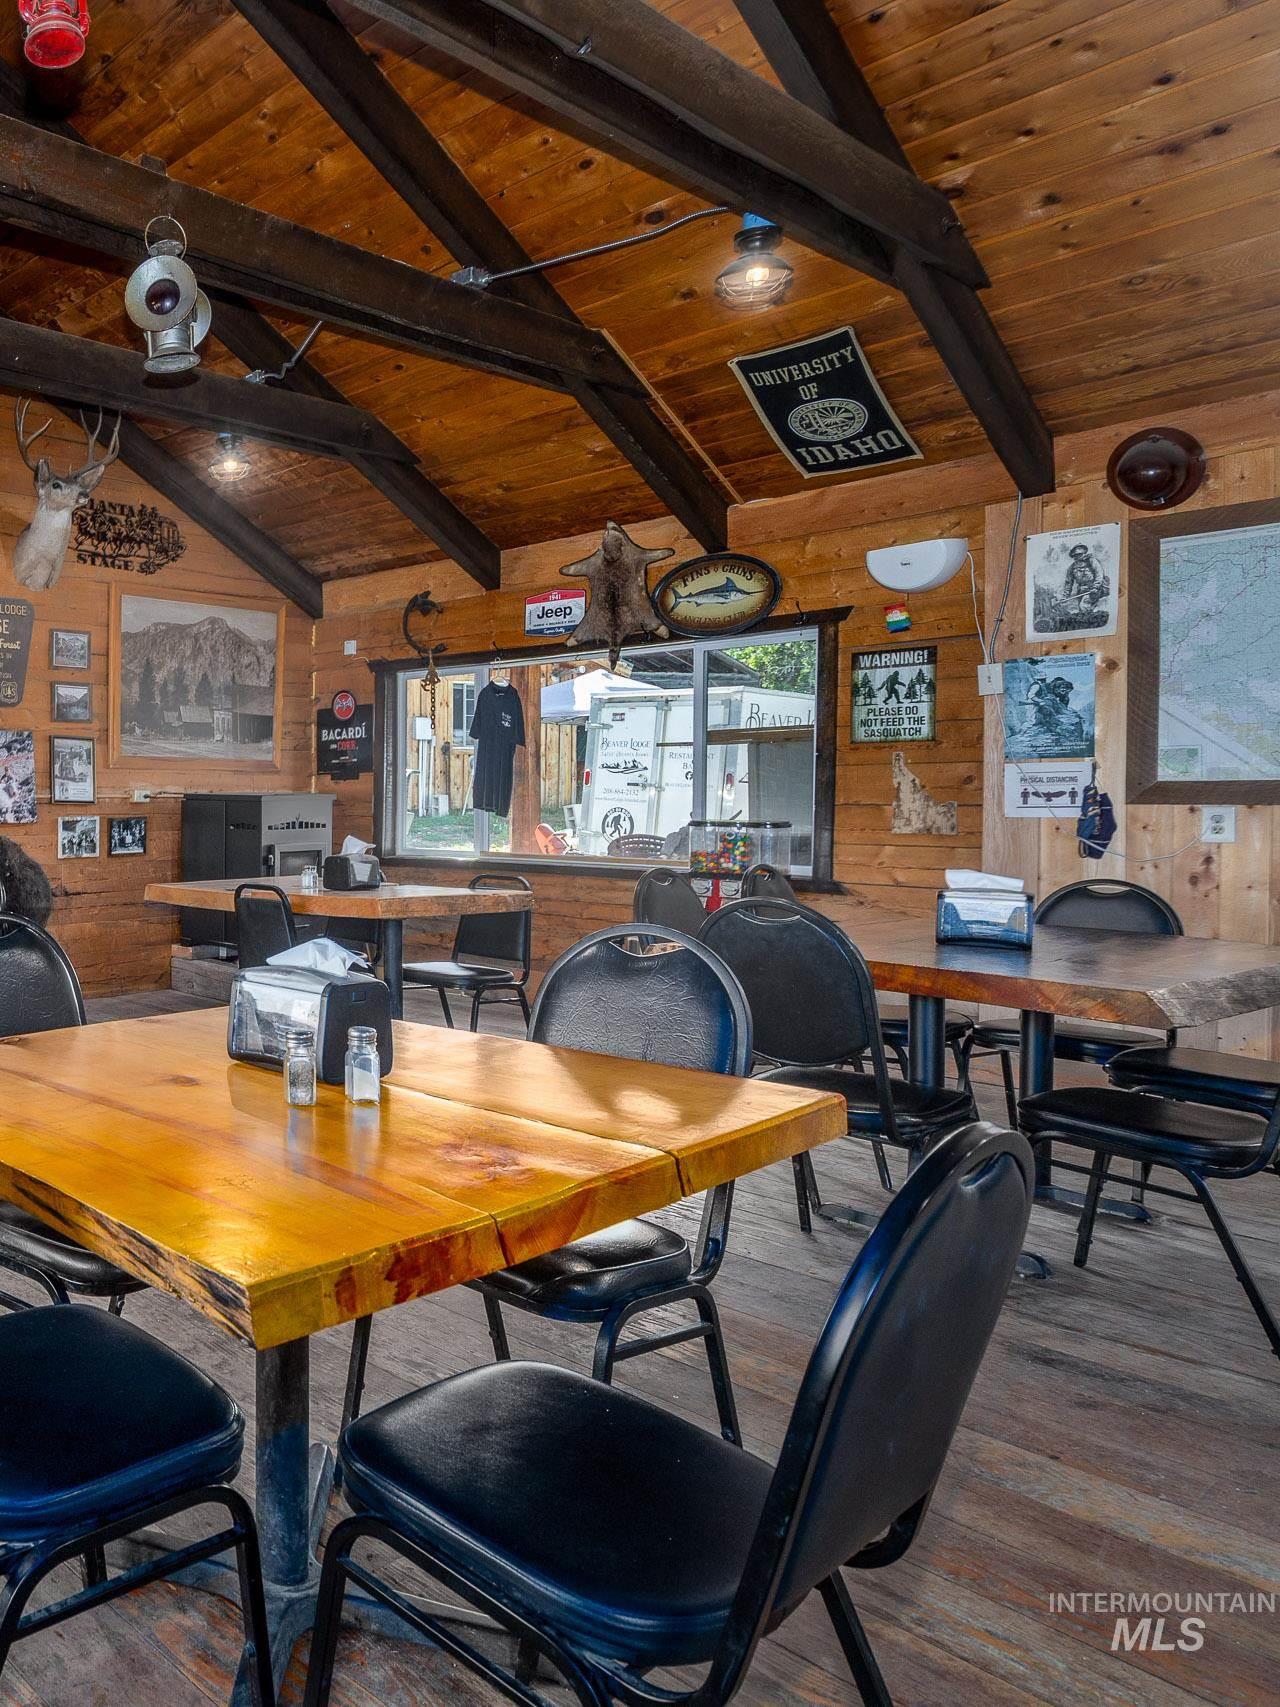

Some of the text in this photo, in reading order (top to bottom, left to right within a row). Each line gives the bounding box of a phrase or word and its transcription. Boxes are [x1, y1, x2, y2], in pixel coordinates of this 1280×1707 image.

[749, 346, 855, 387] UNIVERSITY
[799, 382, 819, 400] OF
[795, 429, 902, 465] IDAHO
[679, 566, 711, 588] FINS
[722, 564, 756, 581] GRINS
[0, 604, 28, 616] LODGE
[537, 605, 573, 619] Jeep
[682, 615, 721, 625] ANGLING
[860, 649, 929, 668] WARNING!
[867, 705, 919, 717] PLEASE DO
[860, 715, 926, 728] NOT FEED THE
[322, 722, 368, 741] BACARDÍ
[864, 727, 922, 738] SASQUATCH
[600, 738, 650, 751] BEAVER LODGE
